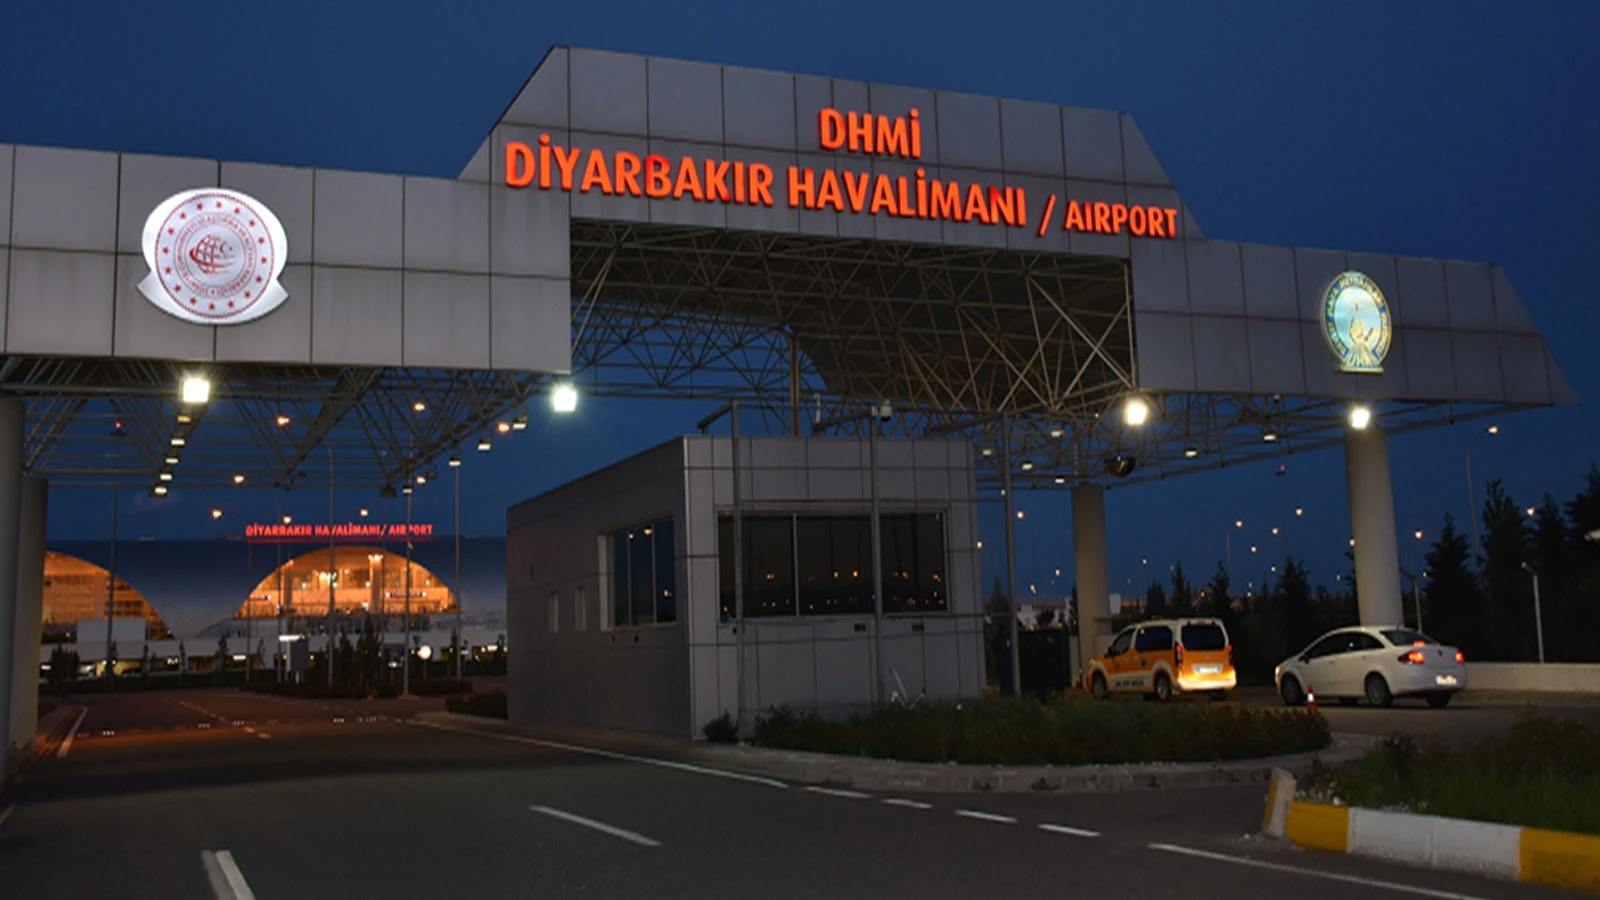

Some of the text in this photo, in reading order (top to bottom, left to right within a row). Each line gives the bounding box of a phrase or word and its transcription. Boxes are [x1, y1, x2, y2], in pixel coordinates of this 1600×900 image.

[820, 107, 923, 158] DHMİ
[505, 133, 1179, 238] DİYARBAKIR HAVALİMANI / AIRPORT
